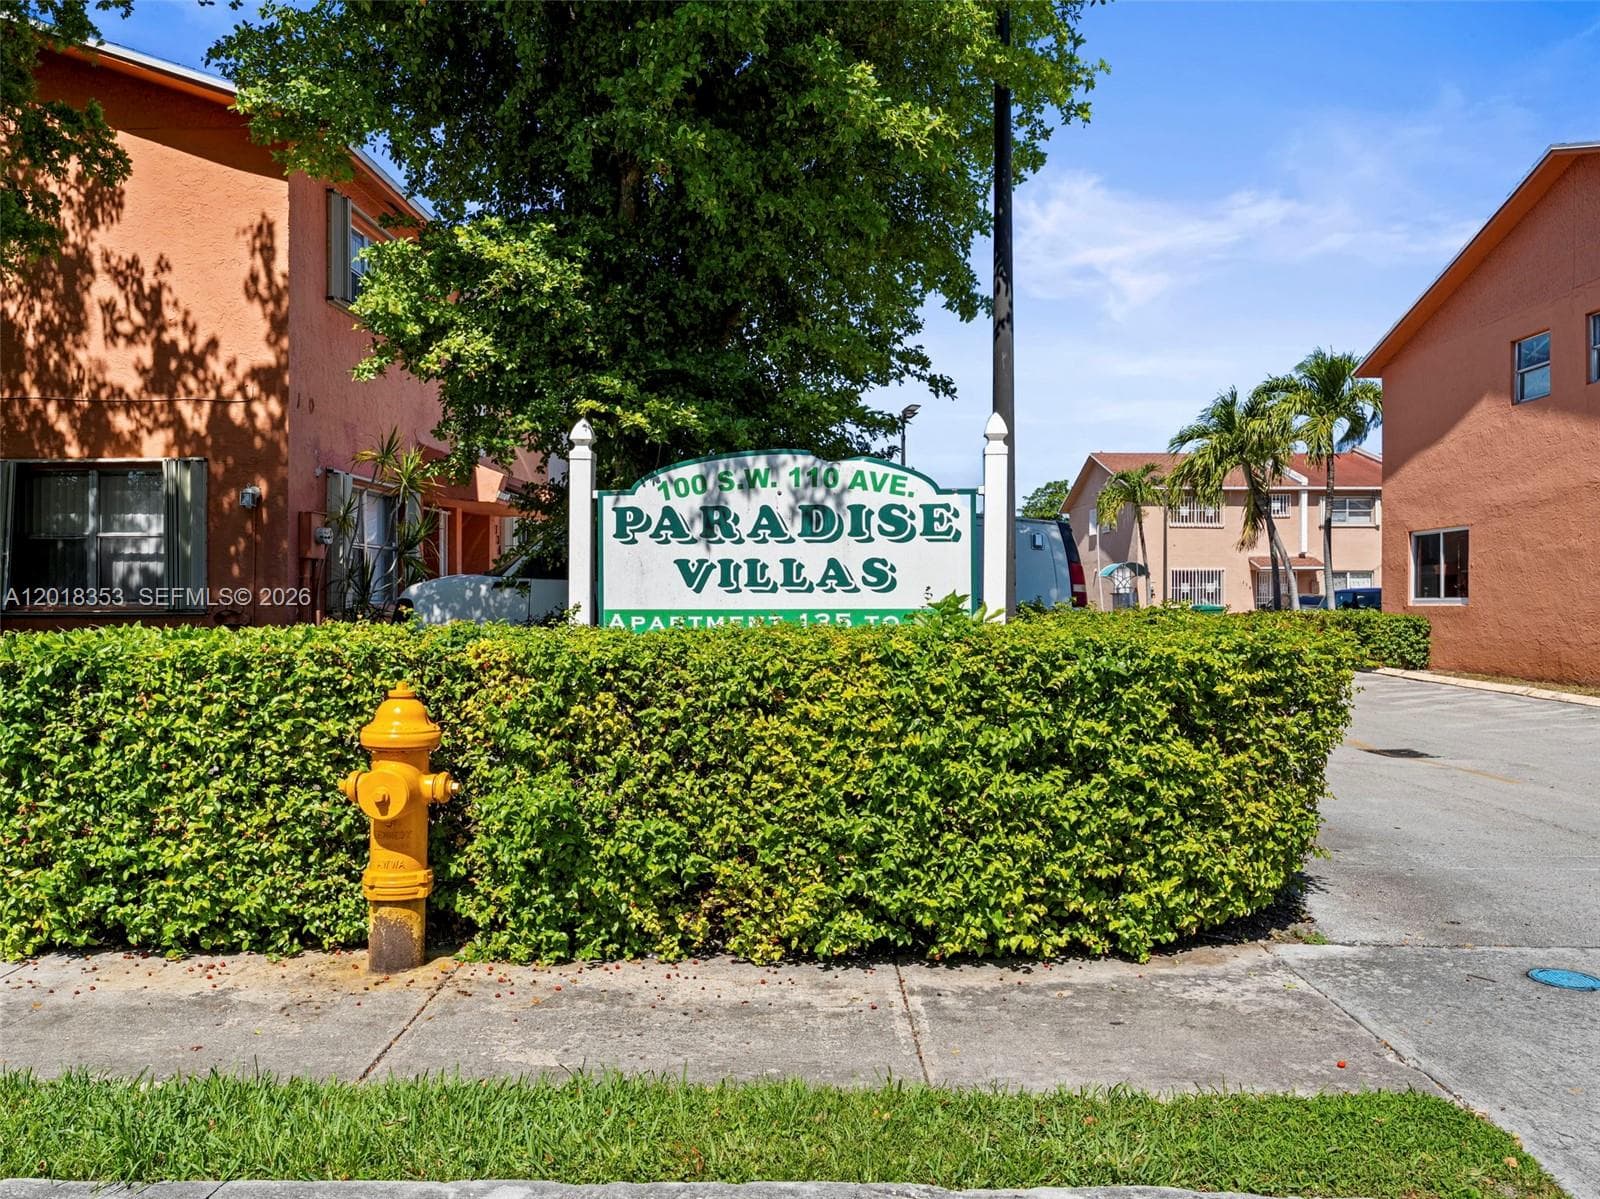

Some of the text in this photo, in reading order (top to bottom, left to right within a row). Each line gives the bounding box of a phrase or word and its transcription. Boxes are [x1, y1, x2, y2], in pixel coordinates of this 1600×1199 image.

[657, 466, 915, 501] 100 S.W. 110 AVE.
[612, 502, 962, 545] PARADISE
[673, 558, 898, 594] VILLAS
